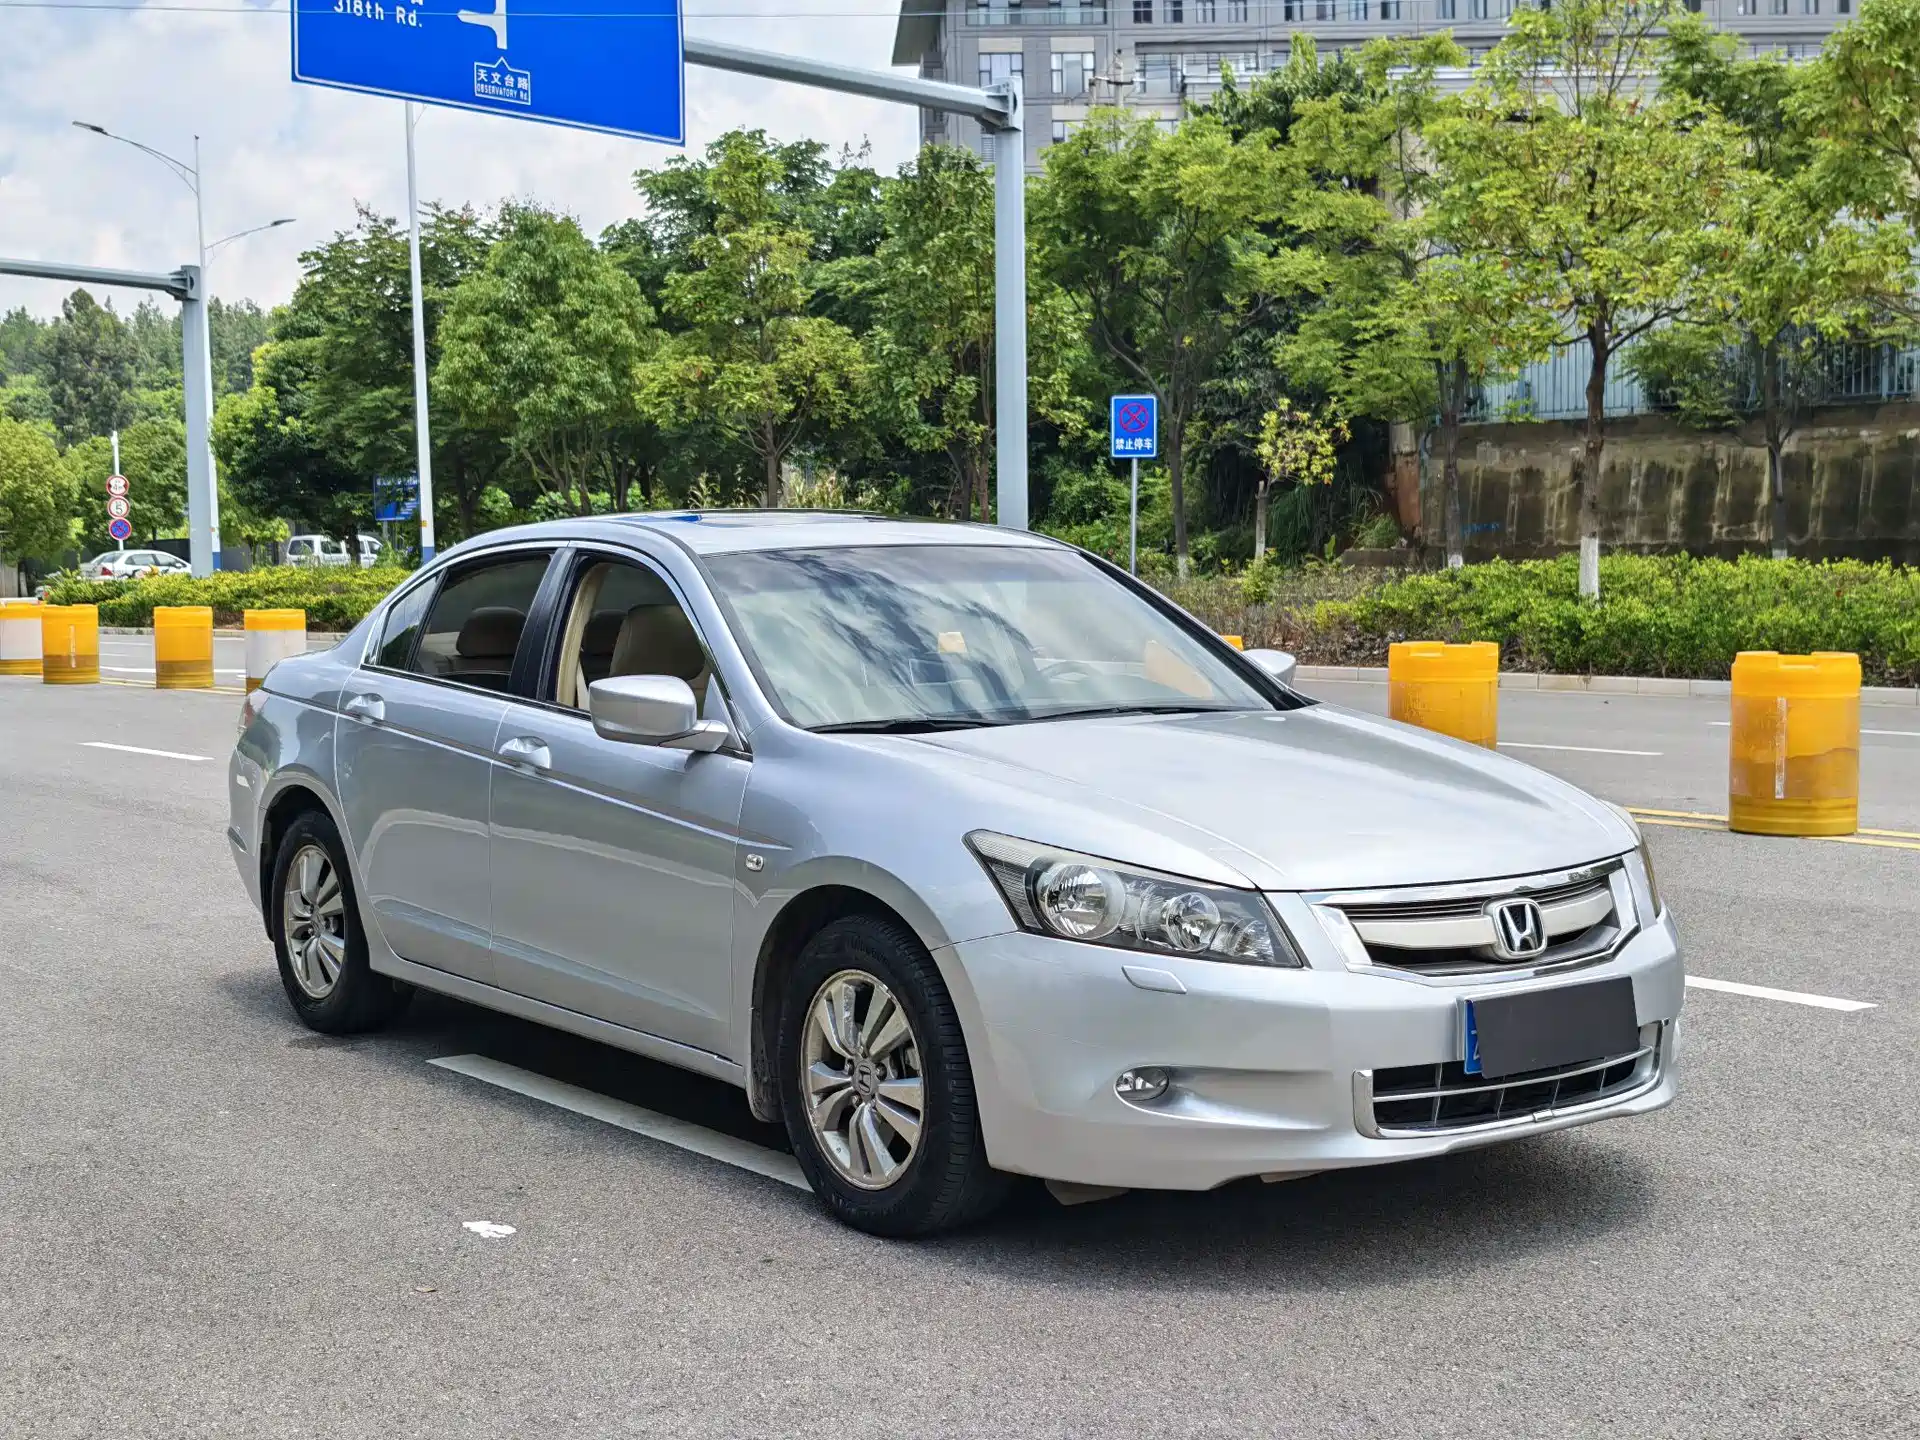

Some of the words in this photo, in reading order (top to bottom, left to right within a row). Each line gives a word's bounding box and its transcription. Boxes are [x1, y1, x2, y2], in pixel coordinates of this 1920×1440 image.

[396, 5, 423, 28] Rd.
[477, 69, 528, 91] 天文台路
[476, 83, 518, 98] OBSERVATORY
[1115, 437, 1153, 450] 禁止停车
